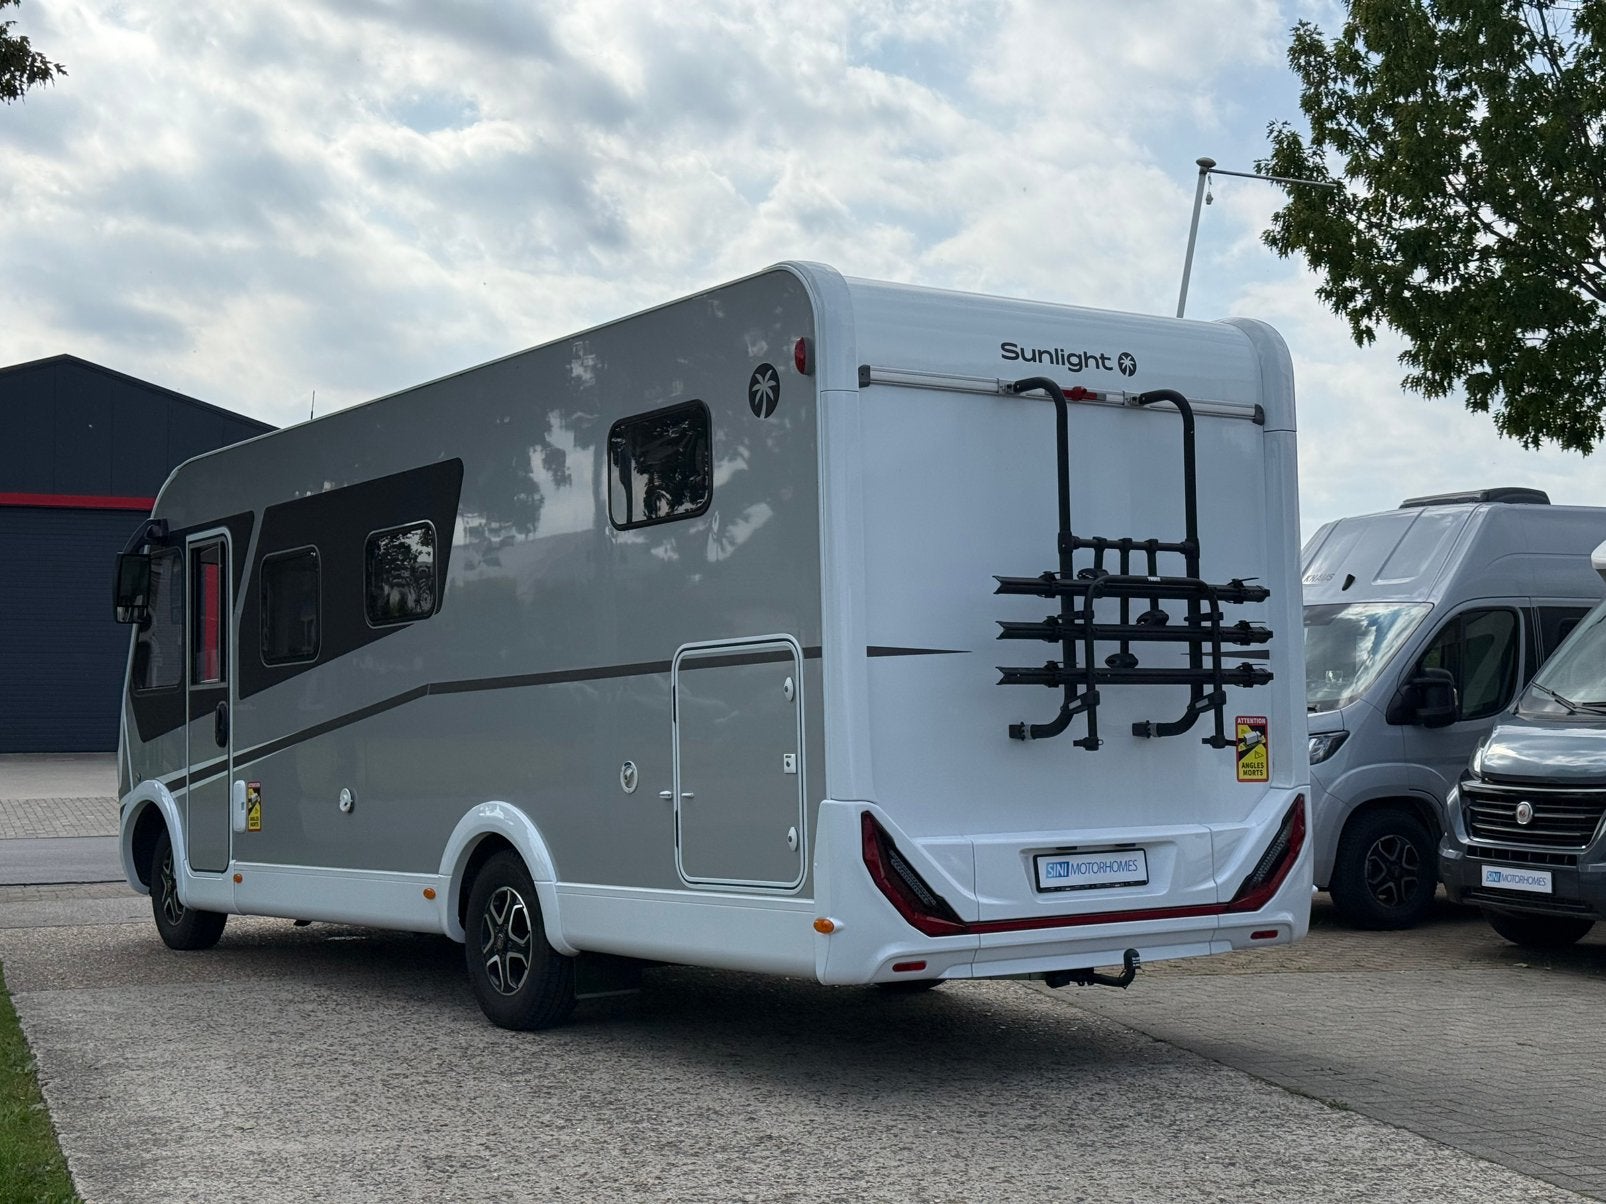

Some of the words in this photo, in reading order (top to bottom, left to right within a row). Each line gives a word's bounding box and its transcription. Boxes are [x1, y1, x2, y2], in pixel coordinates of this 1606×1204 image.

[1000, 342, 1114, 373] Sunlight
[1047, 862, 1068, 878] SINI
[1070, 859, 1138, 876] MOTORHOMES
[1501, 873, 1547, 887] MOTORHOMES
